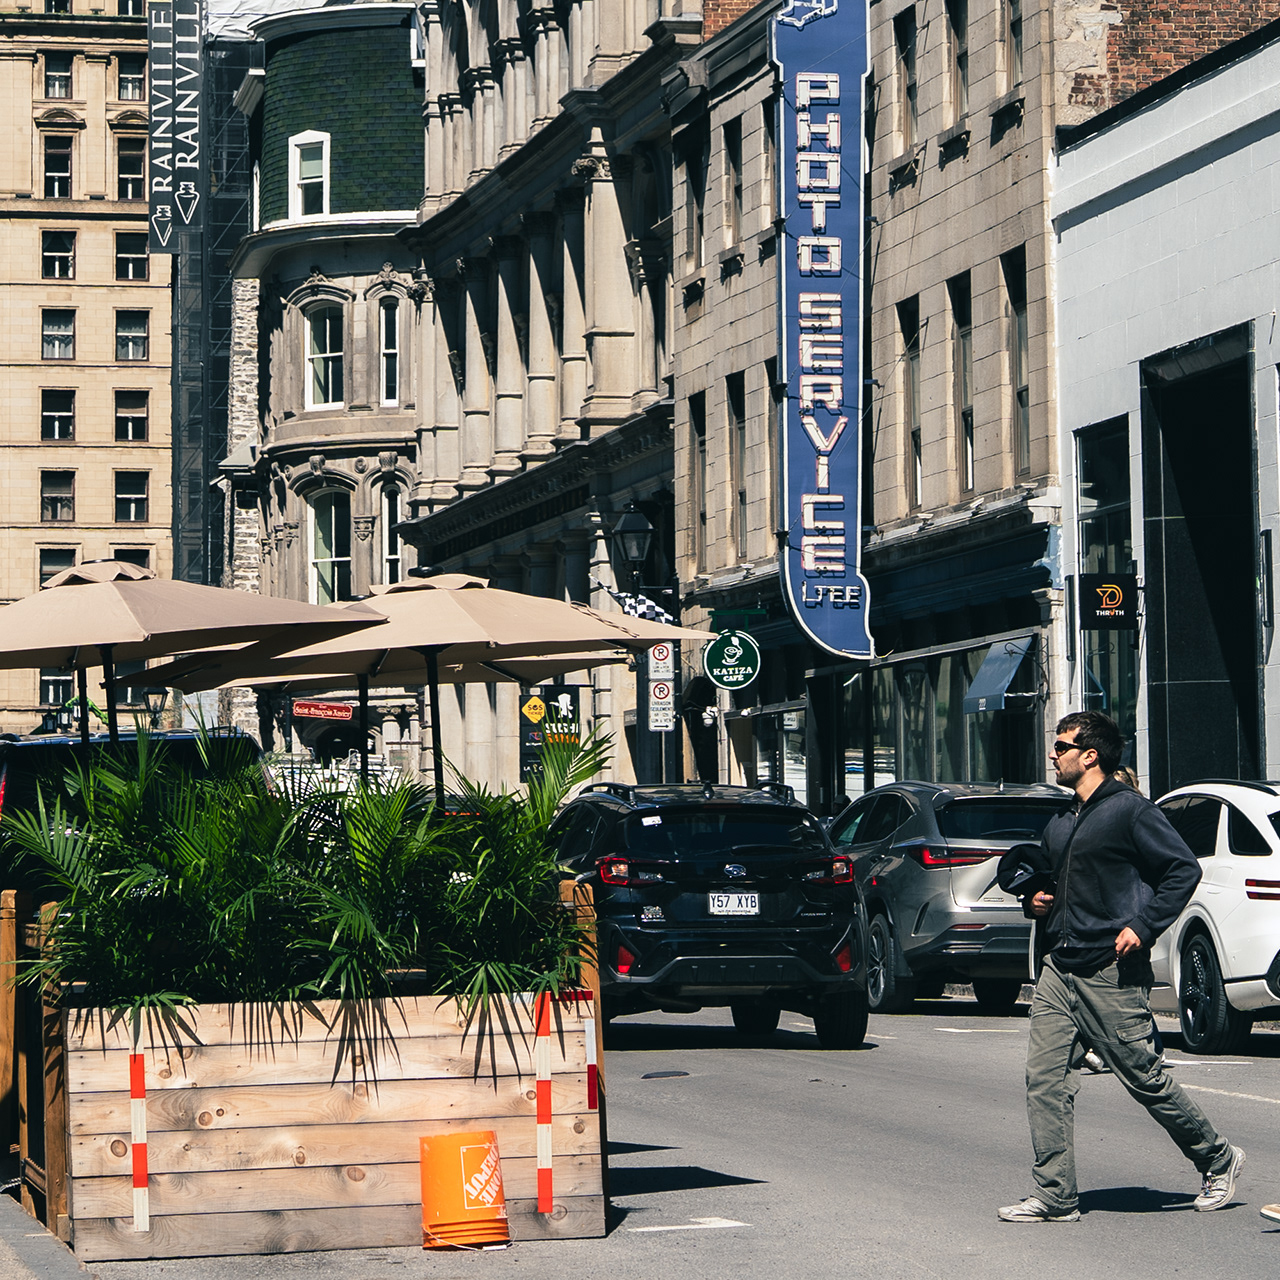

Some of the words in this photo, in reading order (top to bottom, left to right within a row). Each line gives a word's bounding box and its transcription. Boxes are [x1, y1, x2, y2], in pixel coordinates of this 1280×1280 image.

[796, 71, 841, 273] PHOTO
[798, 292, 848, 573] SERVICE
[713, 666, 753, 676] KATIZA
[723, 674, 744, 682] CAFÉ
[710, 895, 730, 908] Y57
[737, 895, 757, 908] XYB
